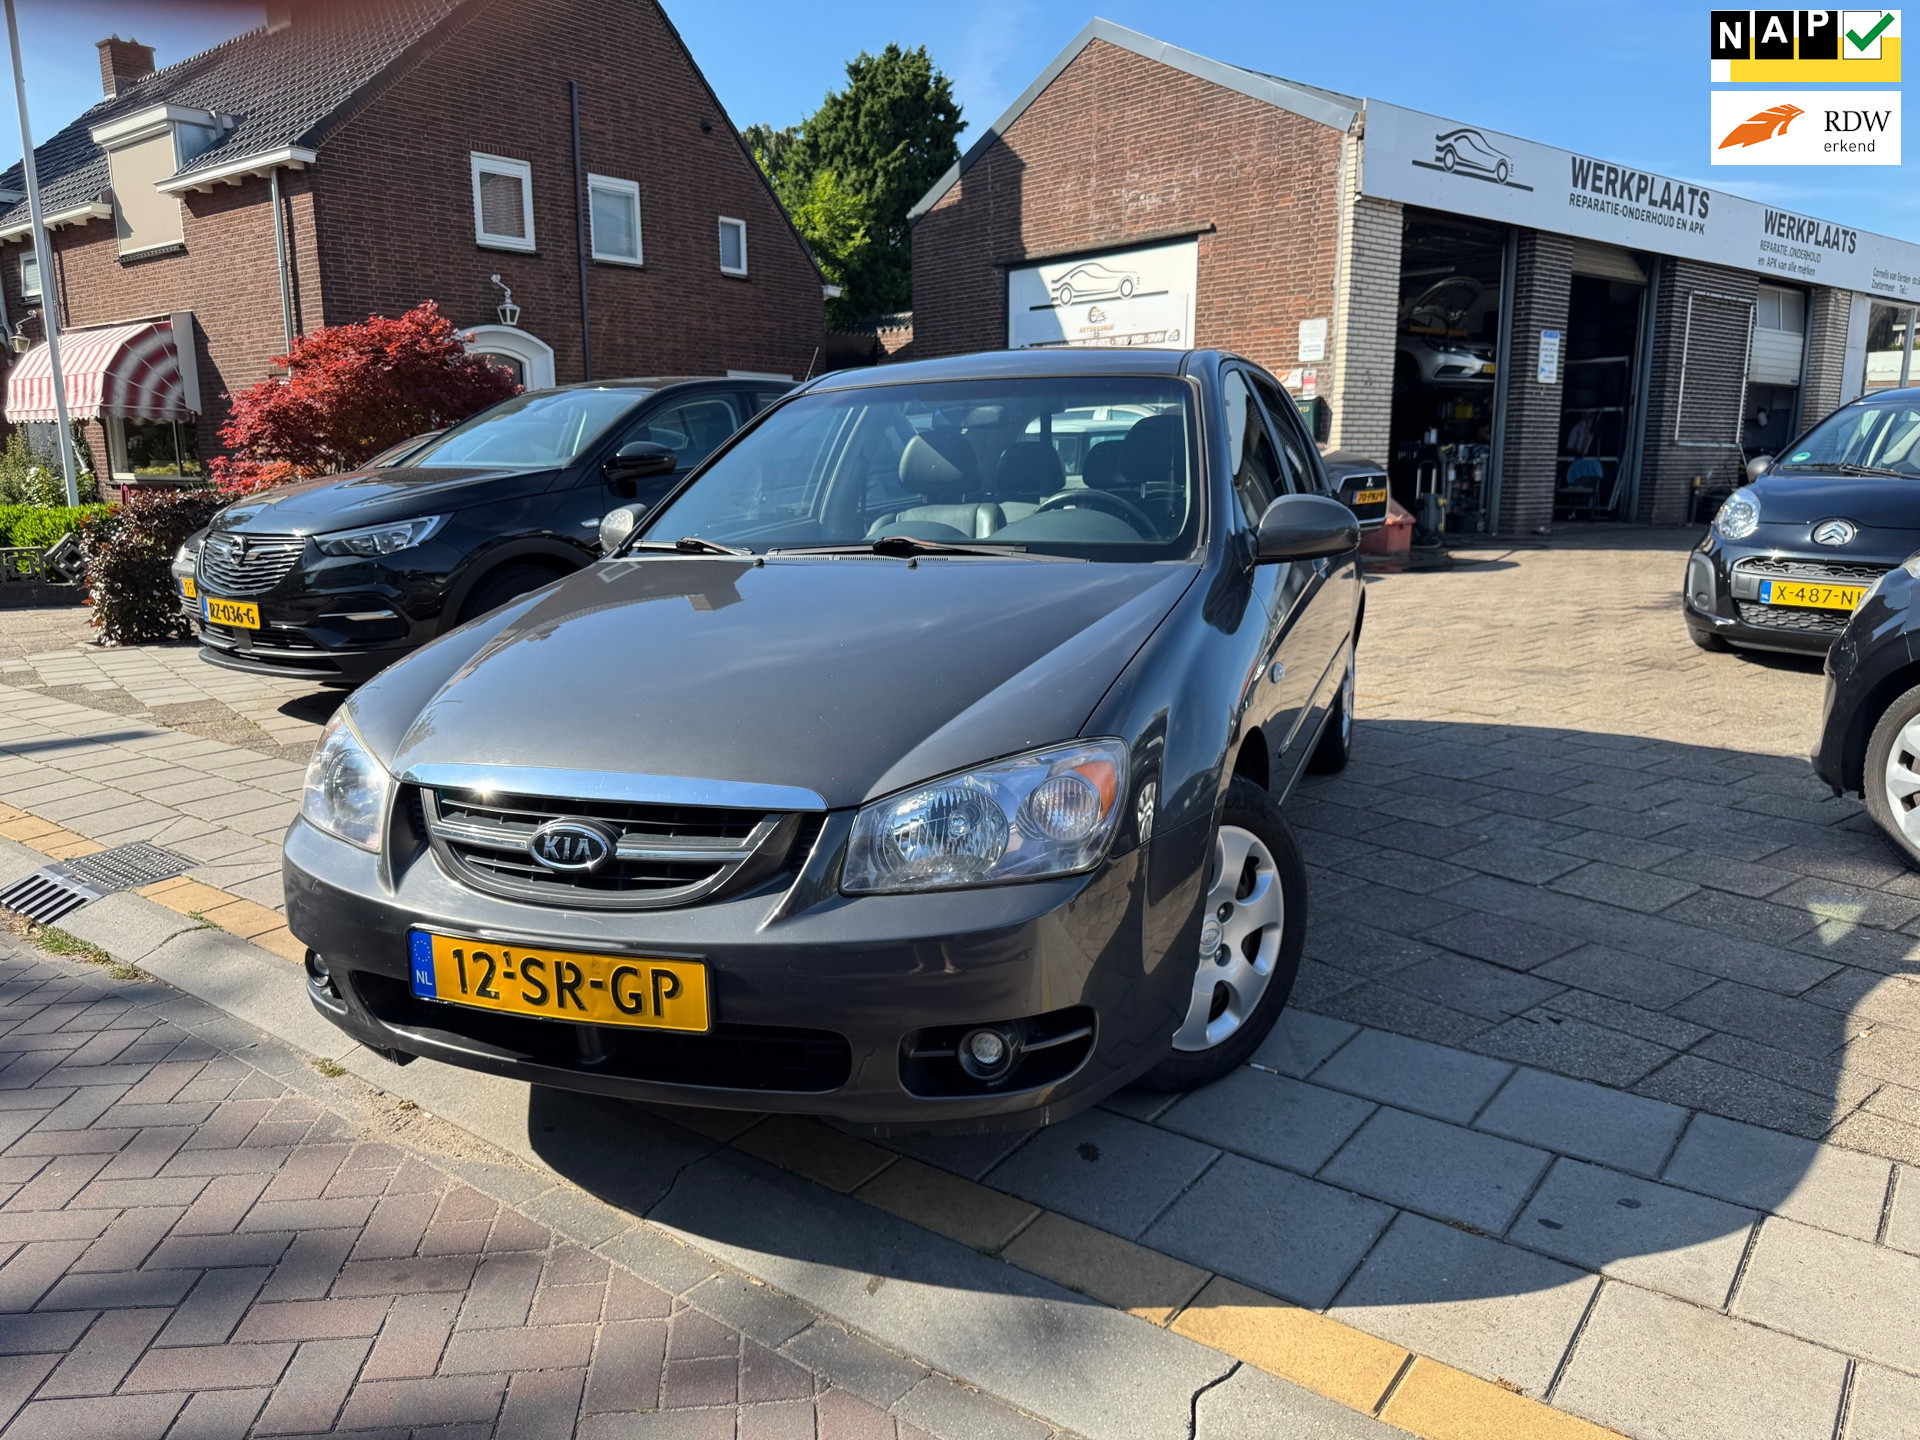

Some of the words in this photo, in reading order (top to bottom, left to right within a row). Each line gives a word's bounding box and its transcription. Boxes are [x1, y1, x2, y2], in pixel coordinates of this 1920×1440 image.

[1571, 156, 1710, 219] WERKPLAATS
[1569, 193, 1674, 228] REPARATIE-ONDERHOUD
[1676, 217, 1687, 231] EN
[1689, 220, 1705, 235] APK
[1764, 209, 1857, 254] WERKPLAATS
[1757, 257, 1764, 266] en
[1766, 257, 1777, 269] APK
[1778, 261, 1787, 270] van
[209, 602, 256, 625] RZ-036-G
[543, 834, 593, 861] KIA
[416, 969, 433, 987] NL
